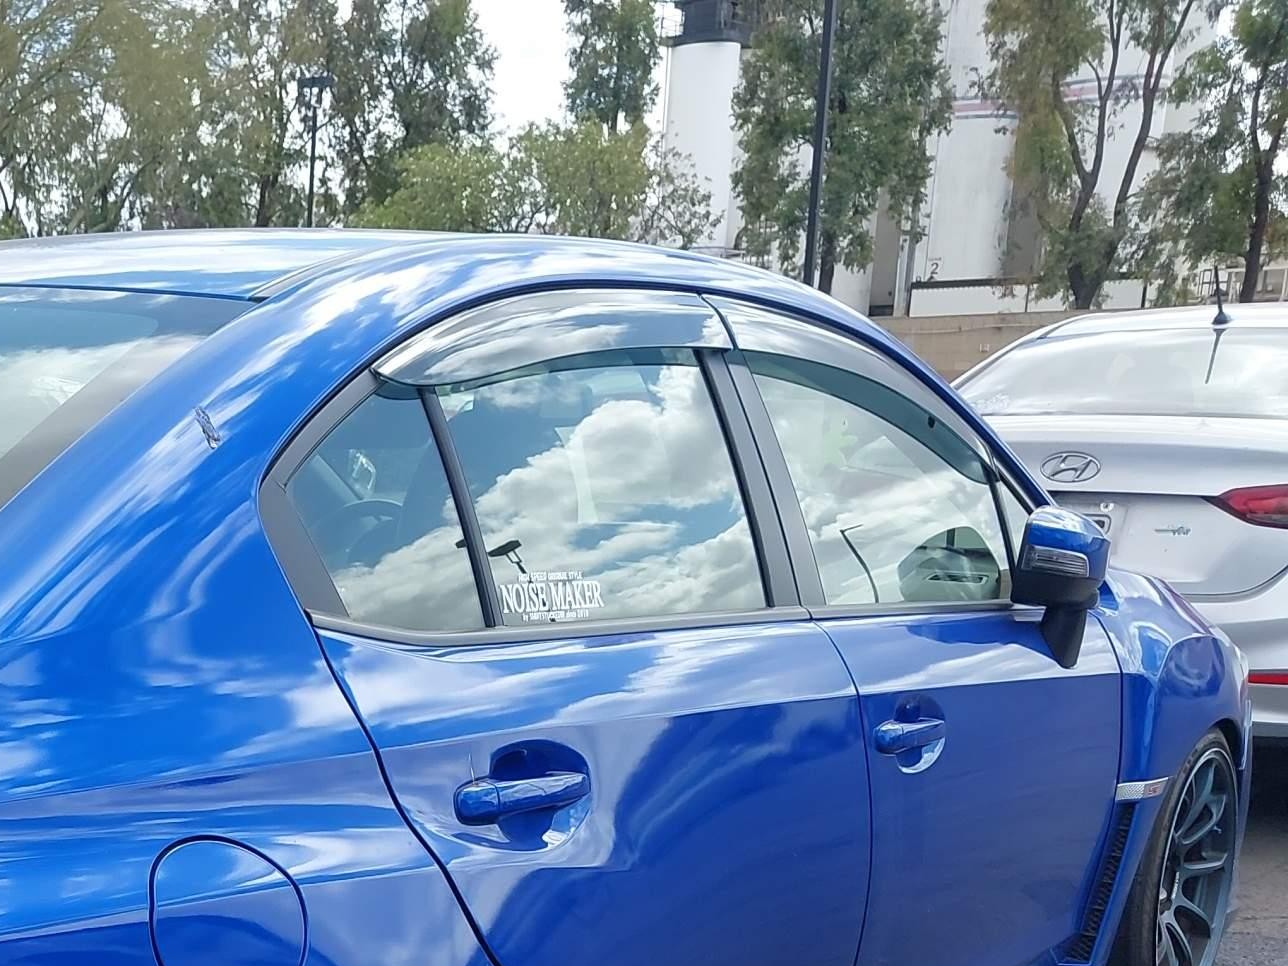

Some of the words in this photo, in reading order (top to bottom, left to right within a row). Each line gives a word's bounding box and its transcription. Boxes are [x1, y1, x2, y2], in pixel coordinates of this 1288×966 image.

[930, 262, 939, 275] 2
[500, 583, 549, 613] NOISE
[549, 580, 604, 611] MAKER
